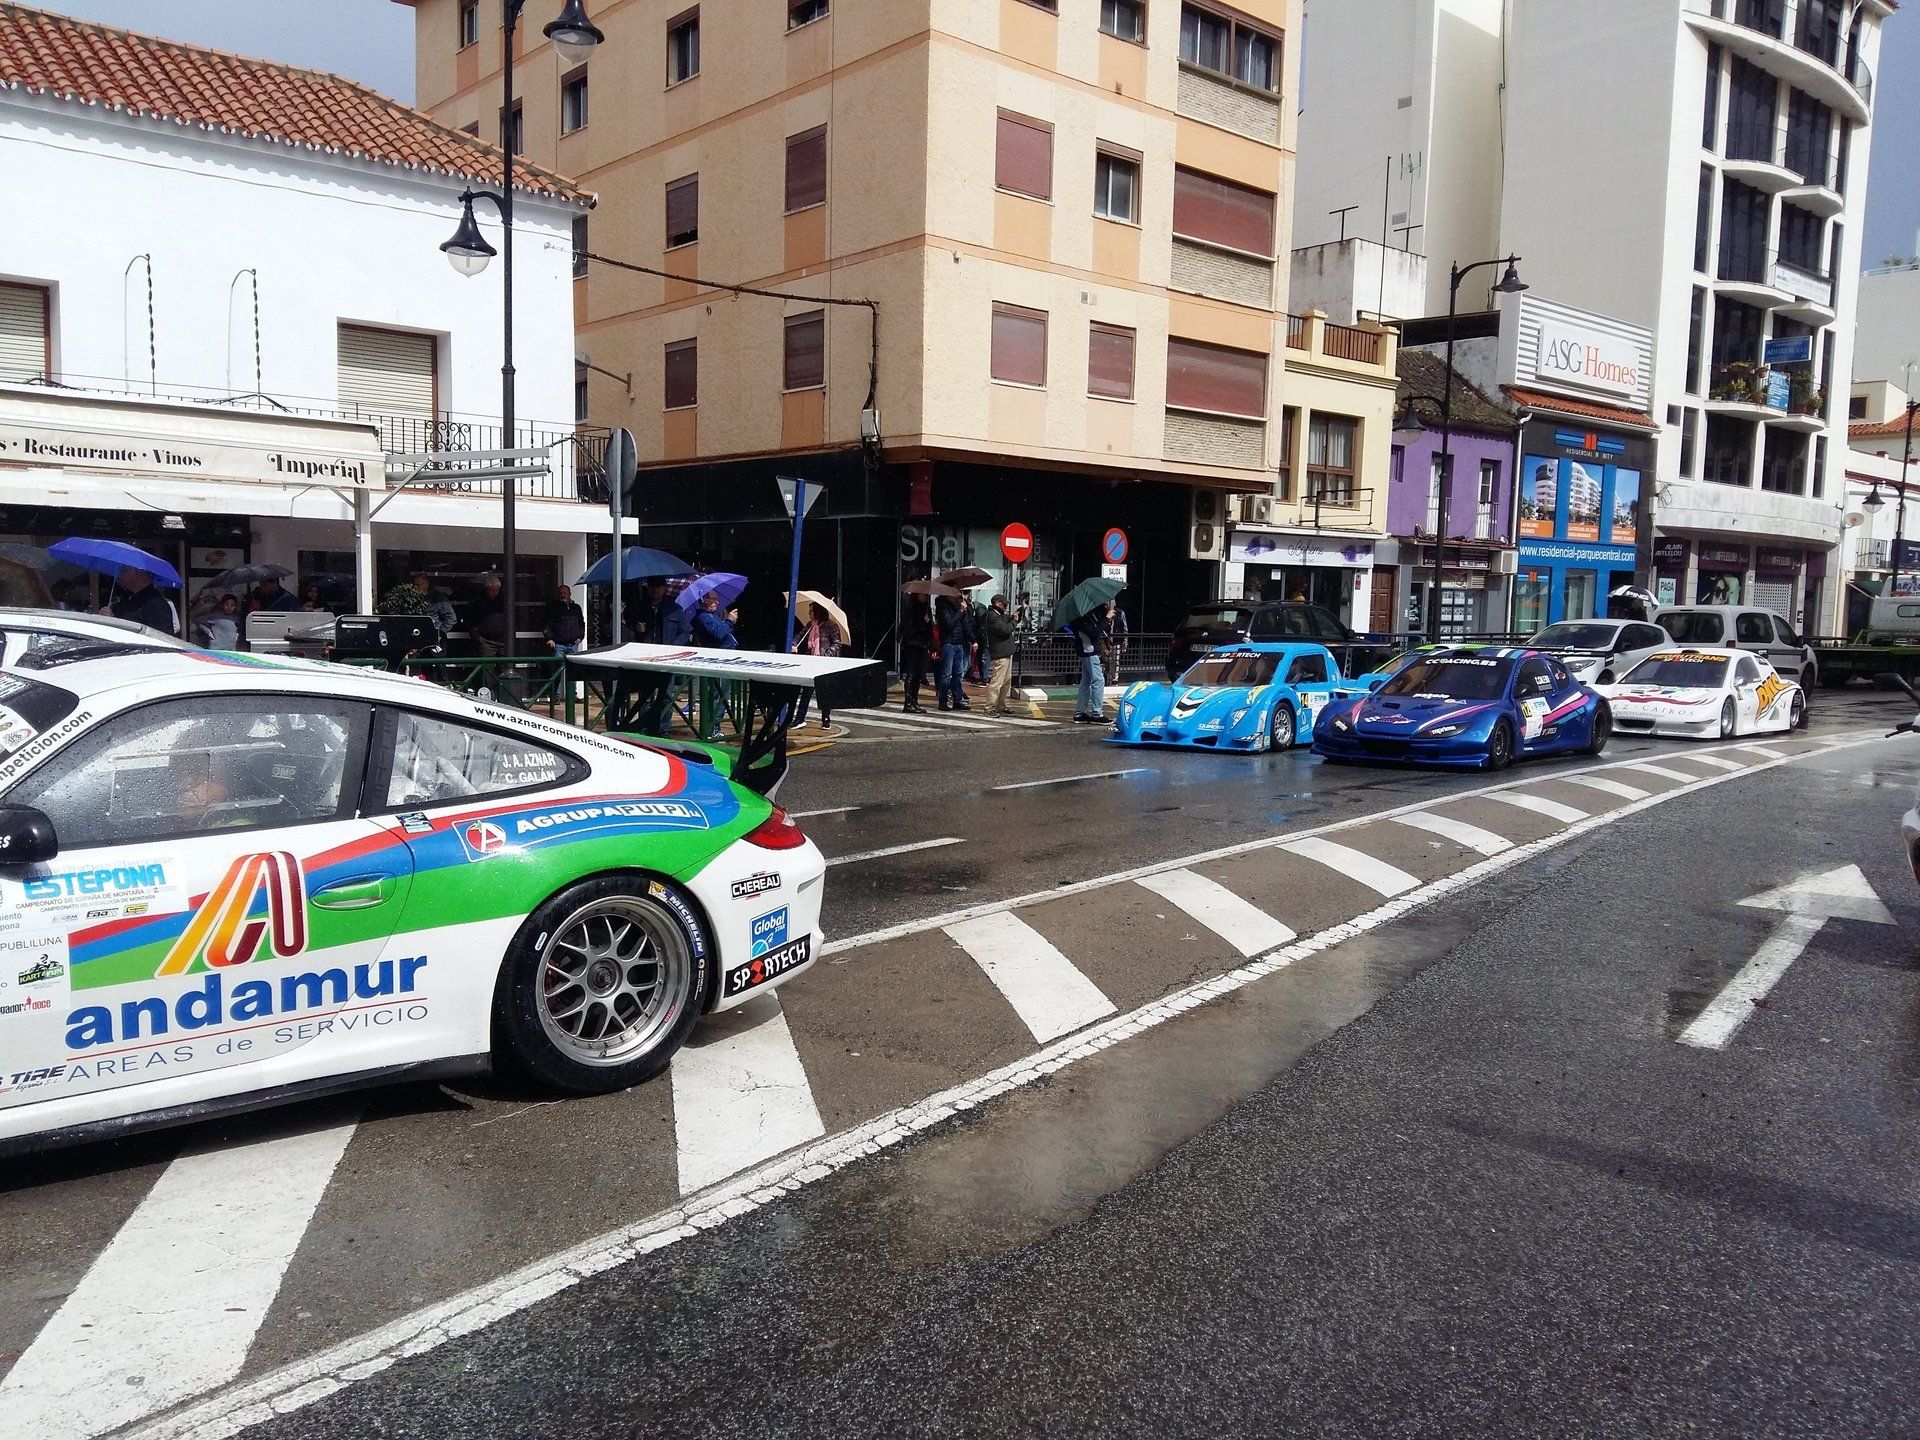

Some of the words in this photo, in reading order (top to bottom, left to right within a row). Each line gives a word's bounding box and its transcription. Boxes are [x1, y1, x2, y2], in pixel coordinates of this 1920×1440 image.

[1544, 338, 1583, 374] ASG
[1584, 345, 1637, 386] Homes
[24, 437, 137, 463] Restaurante
[152, 448, 202, 467] Vinos
[267, 452, 366, 485] Imperial
[1519, 545, 1636, 562] www.residencial-parquecentral.com
[1626, 590, 1650, 601] PING
[1660, 581, 1674, 592] PAGA
[474, 706, 635, 760] www.aznarcompeticion.com
[524, 751, 557, 768] AZNAR
[23, 863, 166, 900] ESTEPONA
[732, 874, 781, 896] CHEREAU
[15, 898, 64, 910] CAMPEONATO
[102, 891, 112, 899] DE
[112, 889, 145, 898] MONTAÑA
[670, 895, 704, 956] MICHELIN
[754, 911, 786, 936] Global
[0, 936, 63, 952] PUBLILUNA
[65, 954, 428, 1050] andamur
[67, 1044, 194, 1084] AREAS
[216, 1037, 253, 1057] de
[274, 1003, 429, 1043] SERVICIO
[10, 1065, 68, 1085] TIRE
